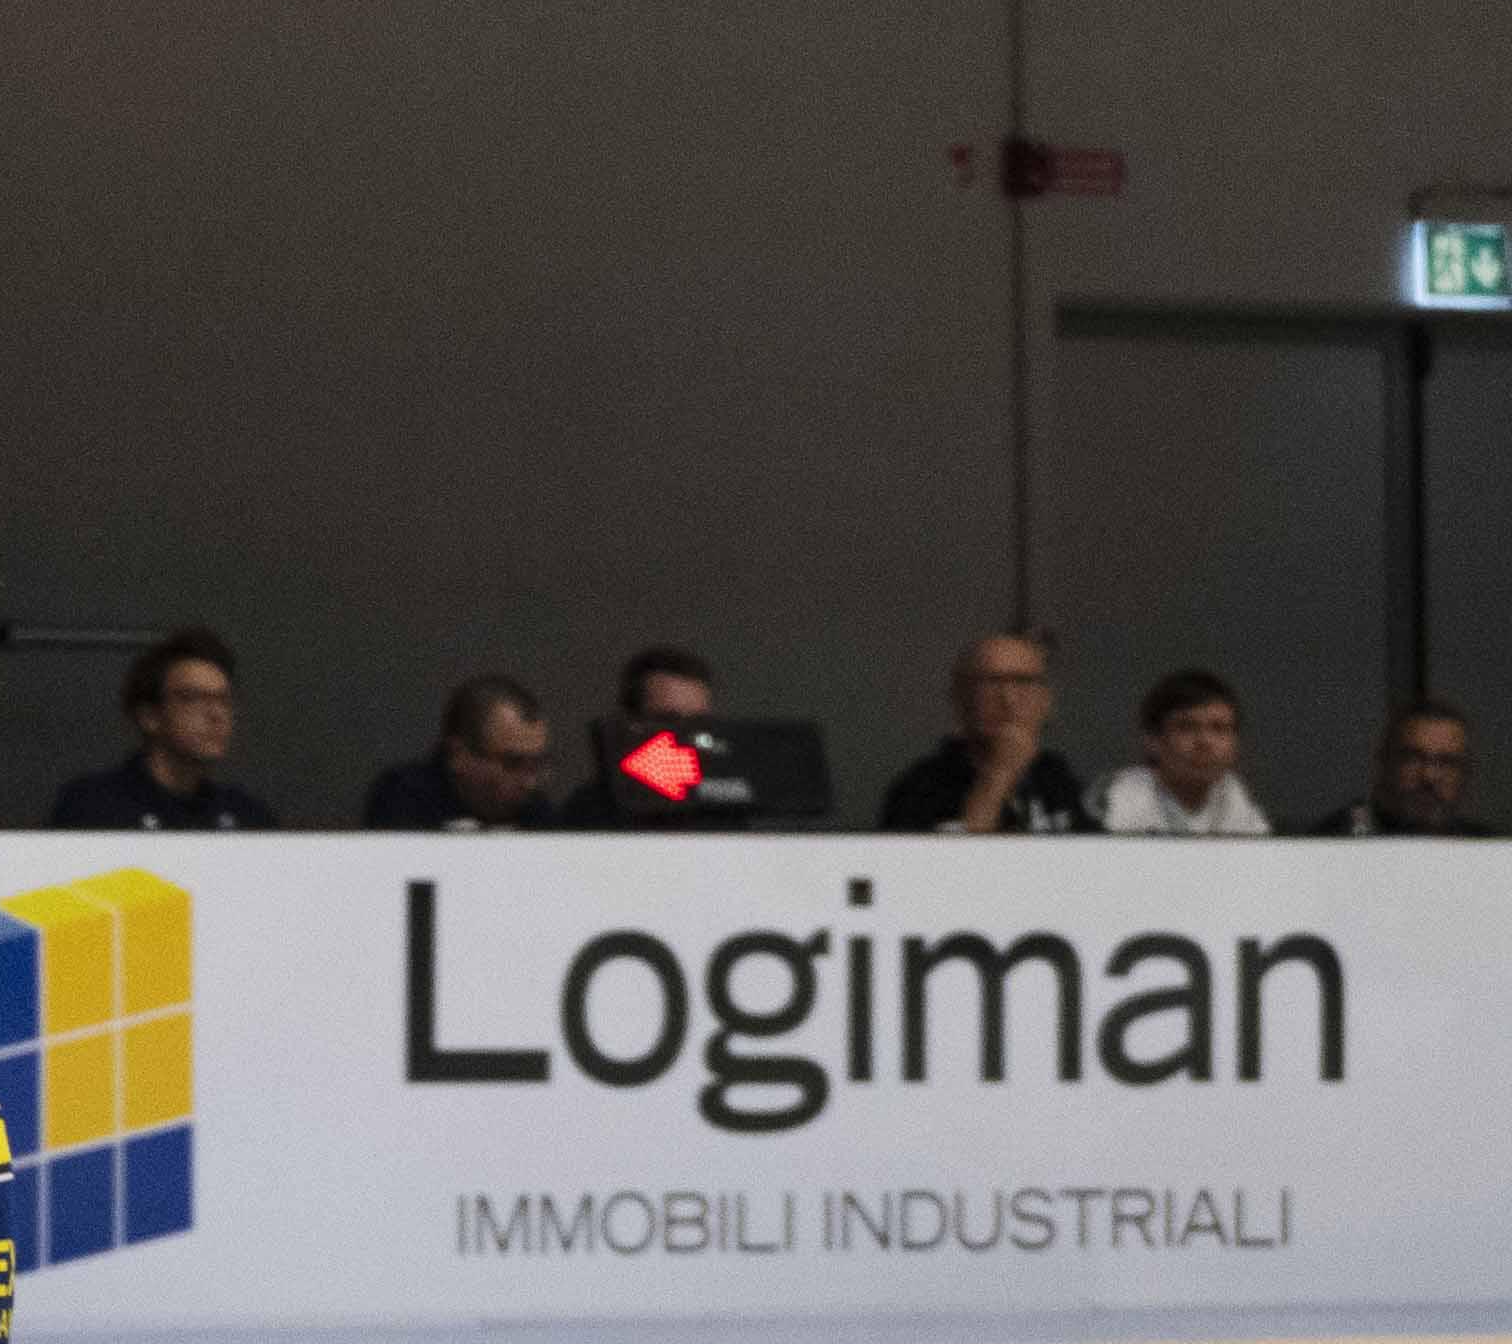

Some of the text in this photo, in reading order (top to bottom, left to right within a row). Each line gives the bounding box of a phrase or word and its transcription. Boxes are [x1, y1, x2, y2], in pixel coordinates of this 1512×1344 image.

[405, 878, 1347, 1135] Logiman
[457, 1185, 1293, 1256] IMMOBILI INDUSTRIALI
